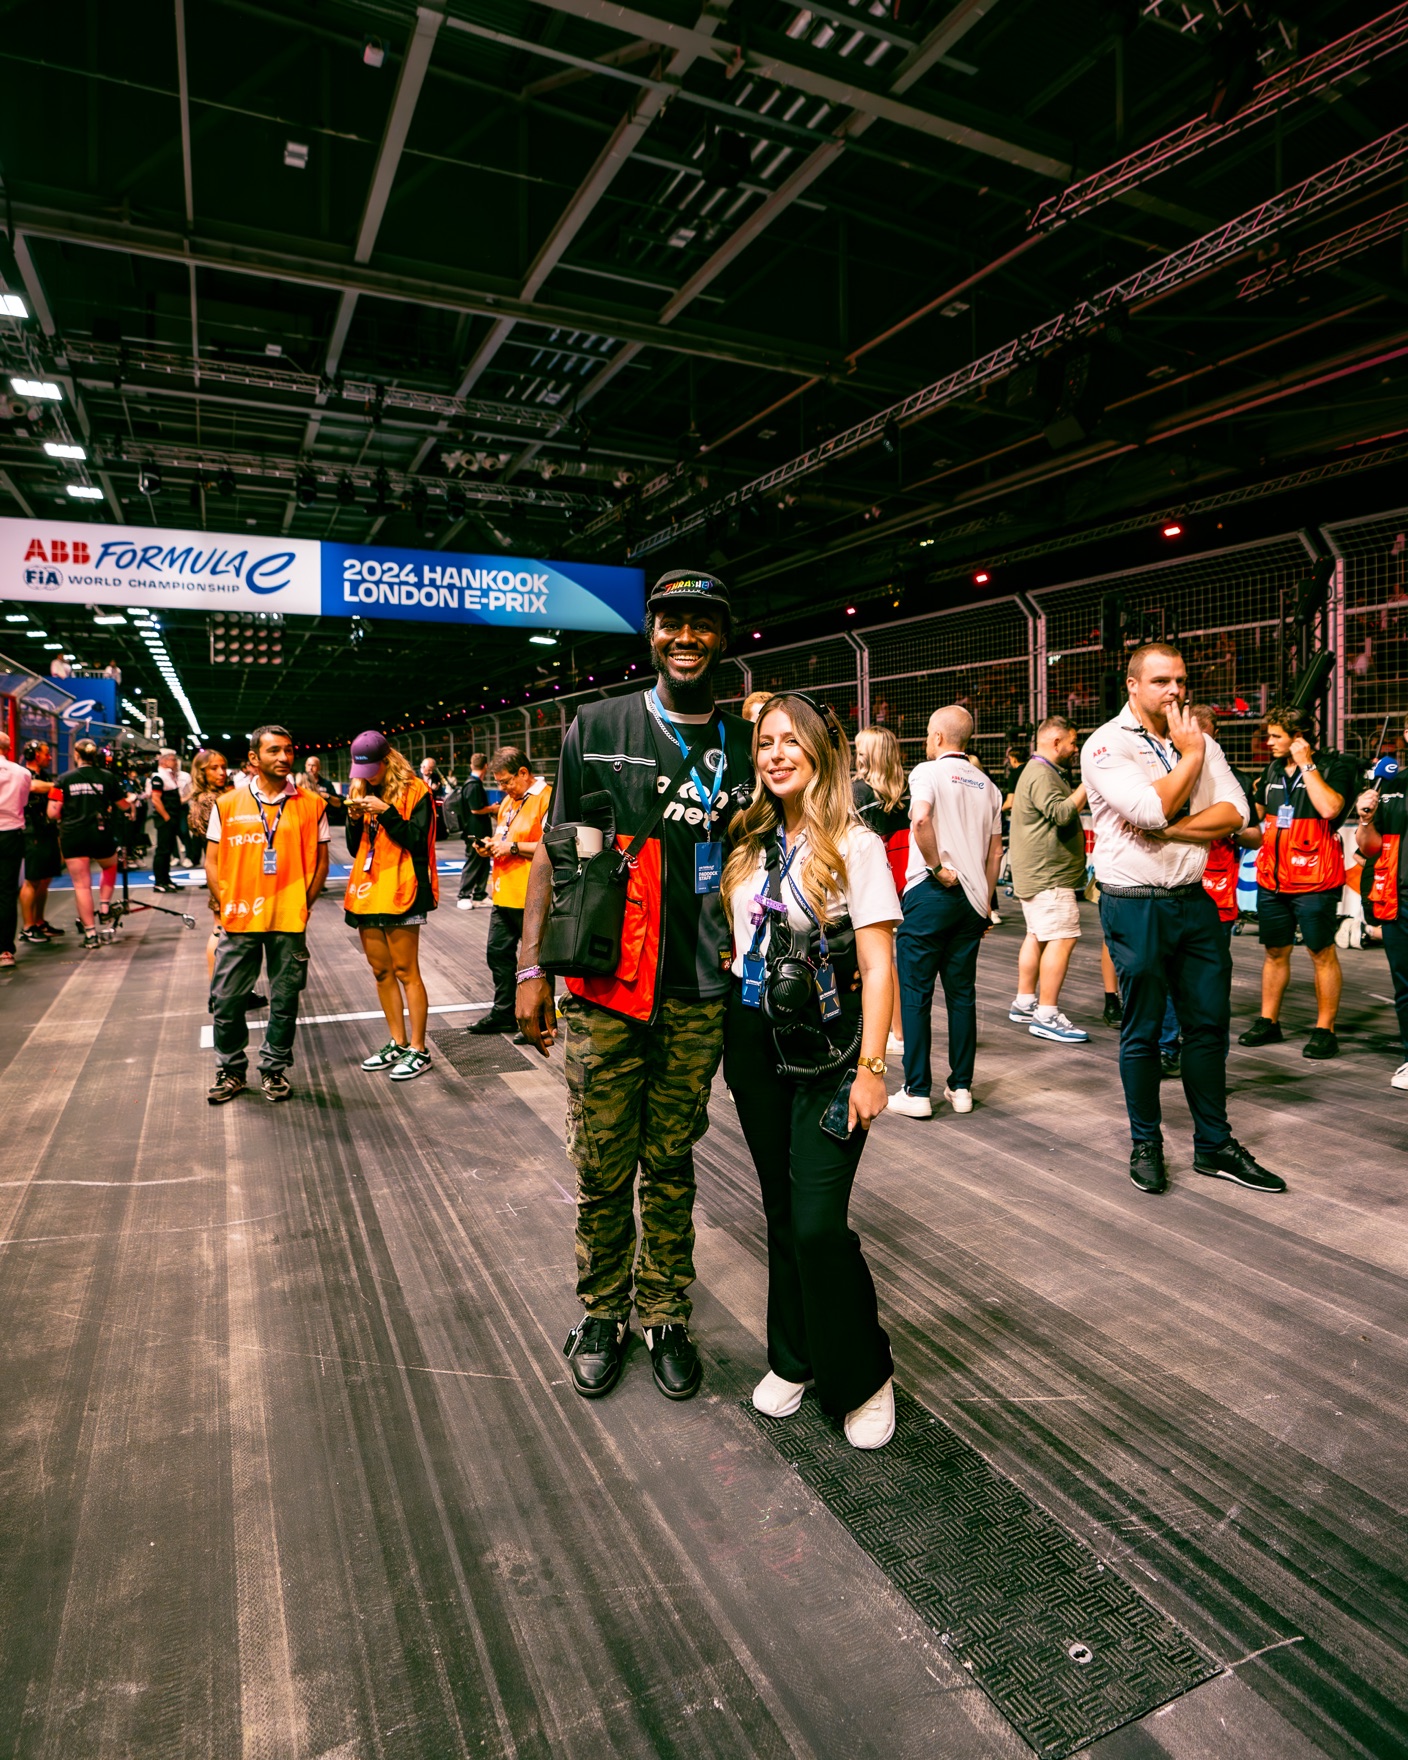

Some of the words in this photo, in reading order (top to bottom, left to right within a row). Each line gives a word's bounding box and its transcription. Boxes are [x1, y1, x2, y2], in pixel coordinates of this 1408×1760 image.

[24, 538, 90, 565] ABB
[68, 575, 122, 588] WORLD
[129, 579, 240, 593] CHAMPIONSHIP
[343, 559, 418, 584] 2024
[423, 565, 549, 593] HANKOOK
[343, 581, 459, 608] LONDON
[464, 589, 548, 614] E-PRIX
